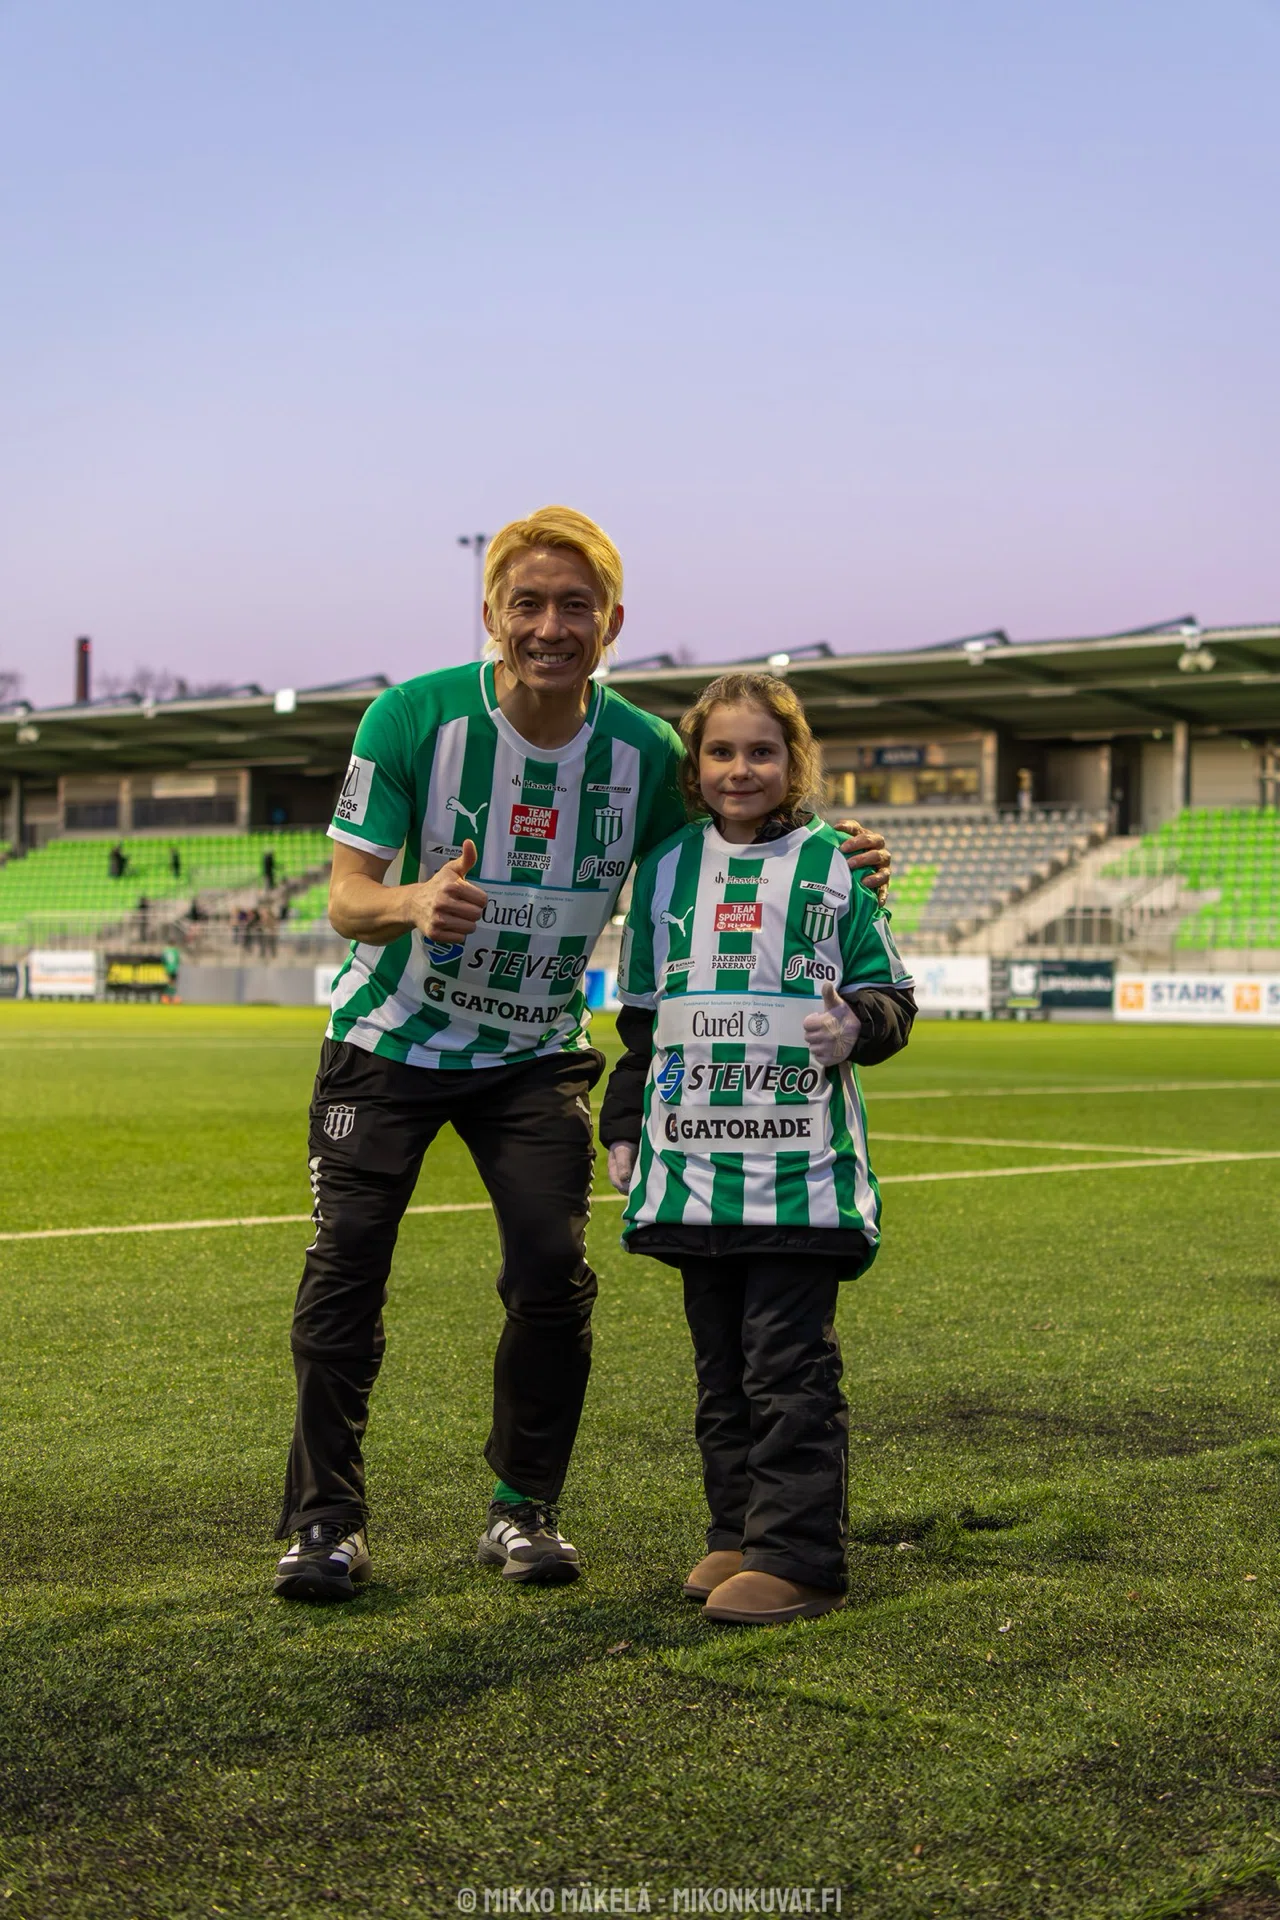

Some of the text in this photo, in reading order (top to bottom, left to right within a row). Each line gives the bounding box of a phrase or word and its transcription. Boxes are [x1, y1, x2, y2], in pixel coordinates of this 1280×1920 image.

[524, 780, 567, 792] Haavisto
[338, 799, 358, 812] KÖS
[337, 808, 351, 820] IGA
[528, 808, 552, 819] TEAM
[514, 815, 550, 828] SPORTIA
[507, 852, 551, 862] RAKENNUS
[507, 860, 550, 870] PAKERA OY
[597, 861, 625, 877] KSO
[727, 876, 769, 885] Haavisto
[481, 899, 534, 928] Curél
[732, 905, 756, 913] TEAM
[811, 906, 829, 914] KTP
[719, 913, 755, 922] SPORTIA
[467, 948, 588, 979] STEVECO
[805, 961, 836, 982] KSO
[1152, 982, 1225, 1003] STARK
[692, 1011, 744, 1037] Curél
[687, 1064, 819, 1094] STEVECO
[681, 1118, 812, 1139] GATORADE
